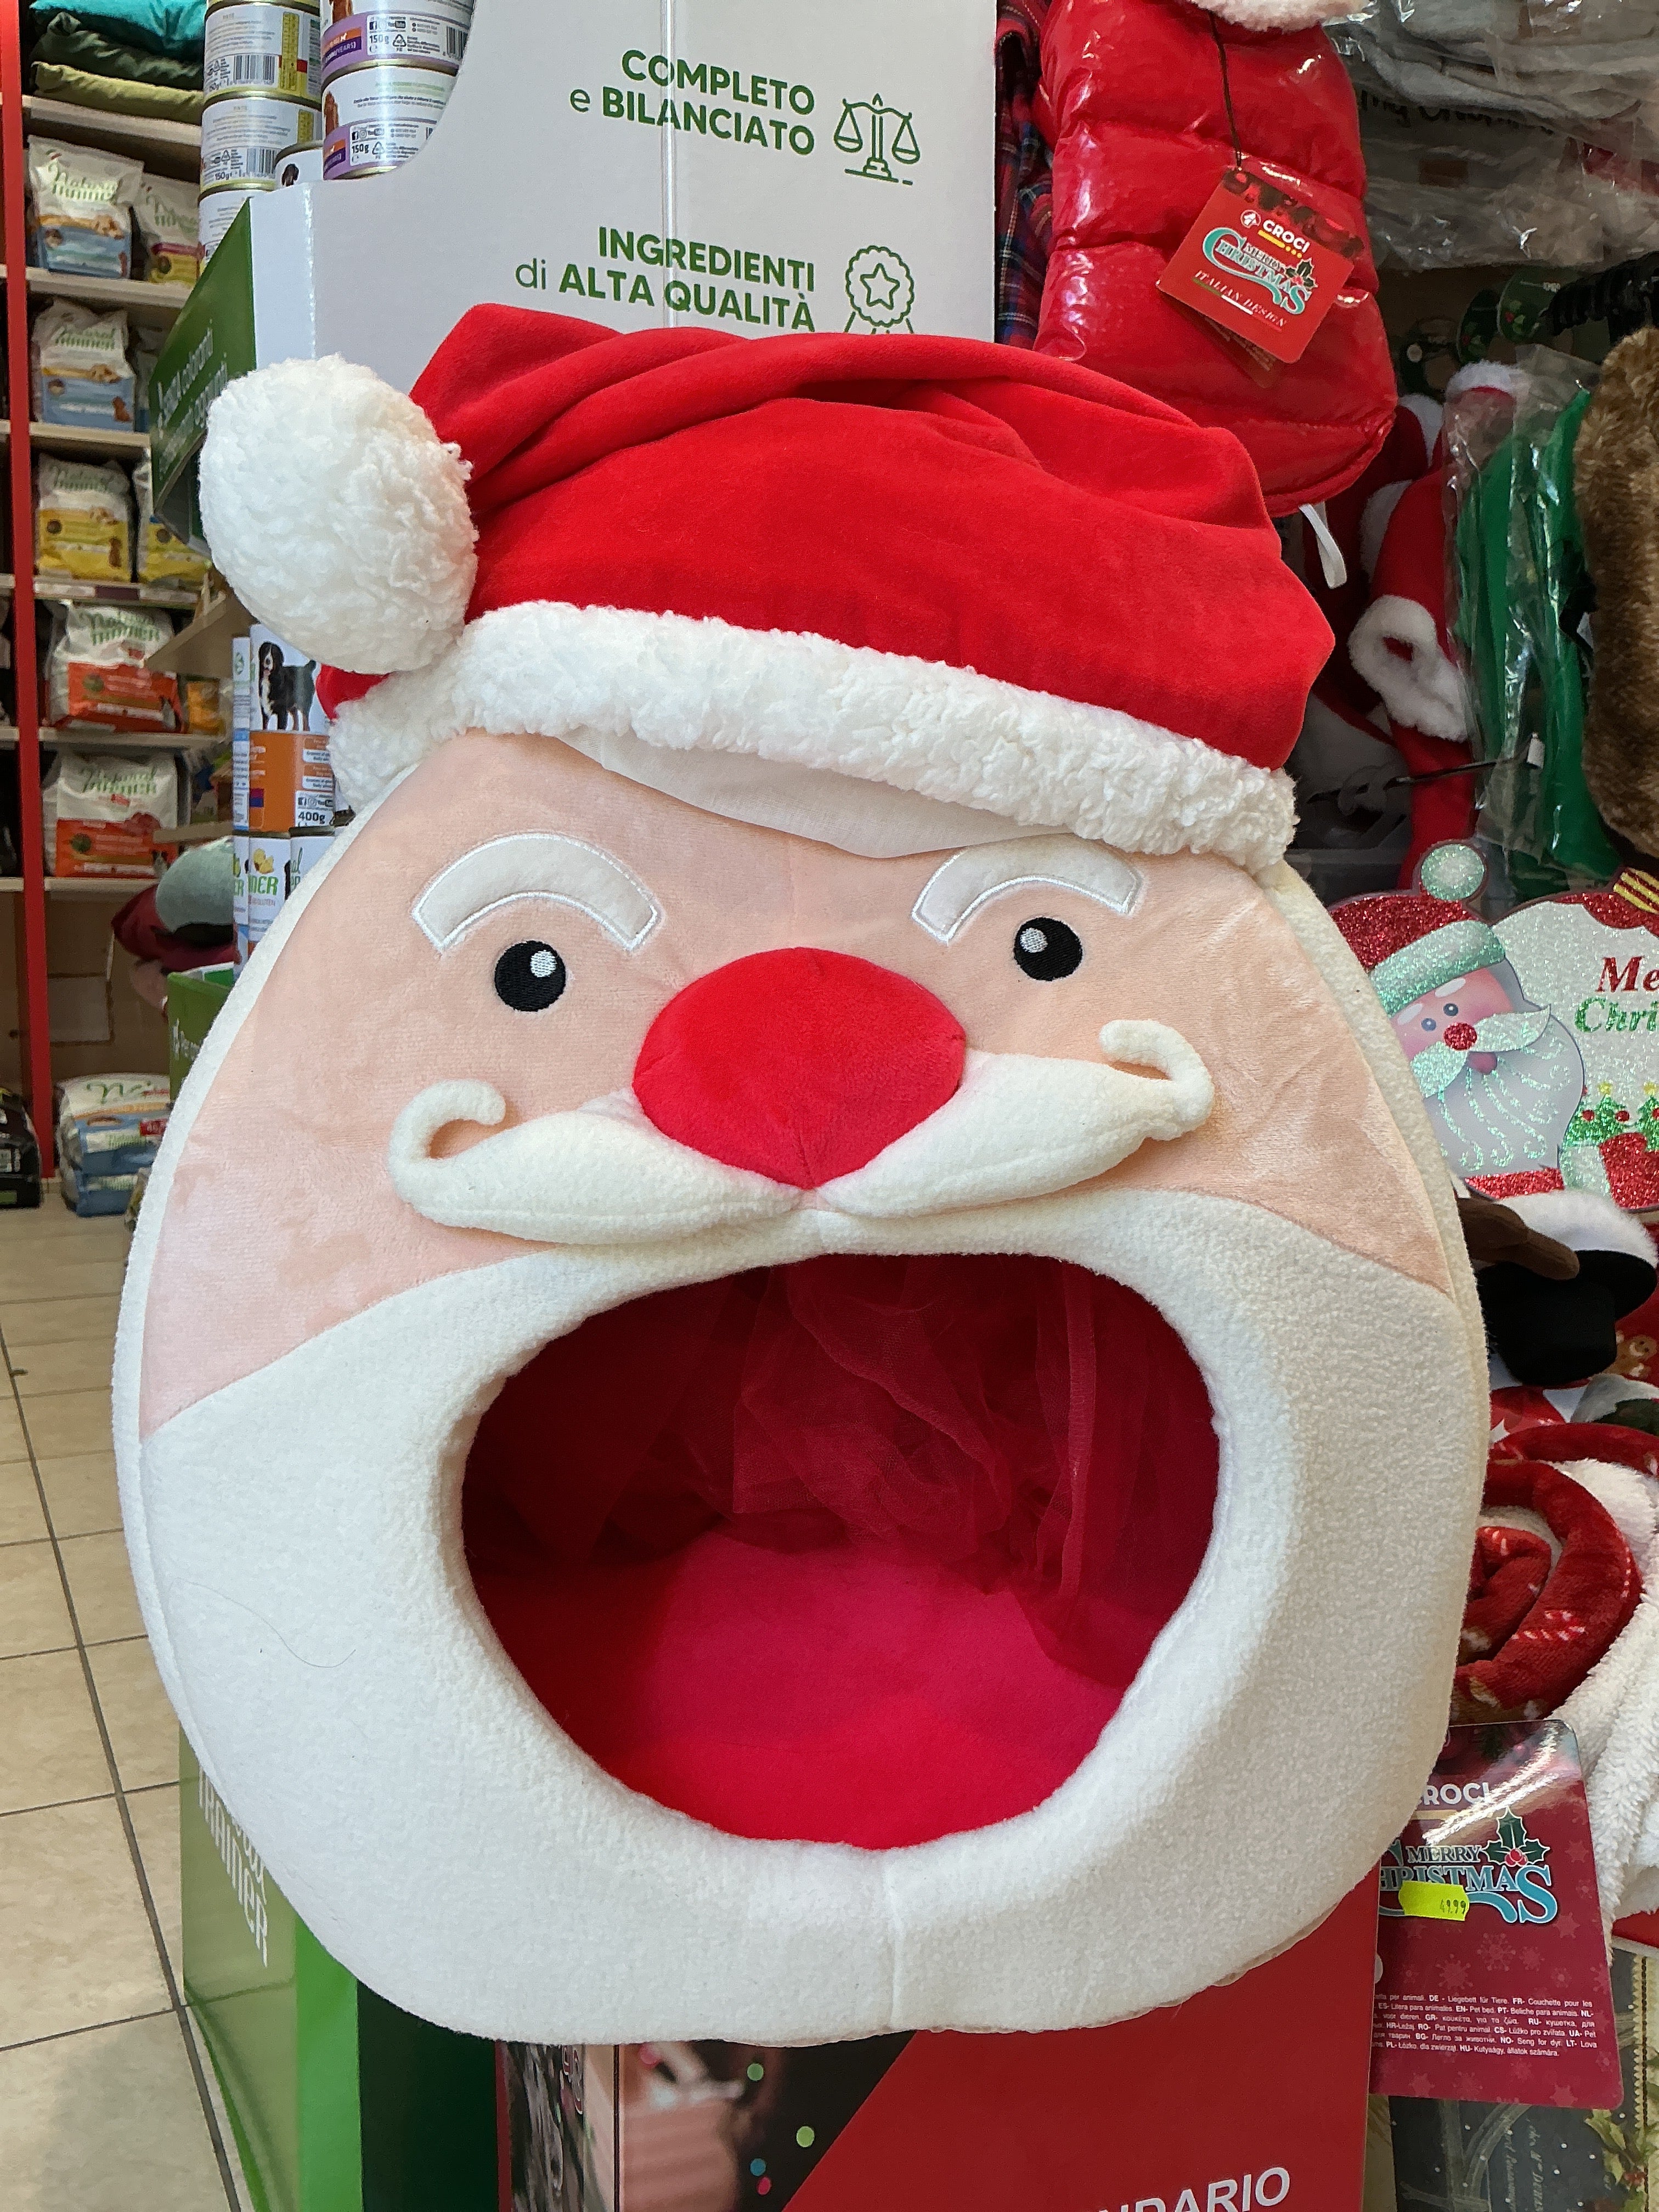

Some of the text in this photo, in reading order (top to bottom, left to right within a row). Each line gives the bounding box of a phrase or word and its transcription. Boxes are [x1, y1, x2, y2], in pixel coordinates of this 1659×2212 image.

[369, 35, 389, 44] 150g
[622, 49, 815, 115] COMPLETO
[570, 87, 815, 155] e BILANCIATO
[352, 144, 369, 154] 150g
[1263, 219, 1311, 253] CROCI
[599, 226, 815, 292] INGREDIENTI
[1203, 227, 1313, 315] CHRISTMAS
[1243, 243, 1286, 271] MERRY
[515, 258, 815, 332] di ALTA QUALITÀ
[1195, 270, 1287, 327] ITALIAN DESIGN
[298, 811, 326, 825] 400g
[1423, 1782, 1489, 1805] ROCI
[1406, 1845, 1483, 1864] MERRY
[1379, 1840, 1558, 1924] HRISTMAS
[1528, 1998, 1561, 2006] Couchette
